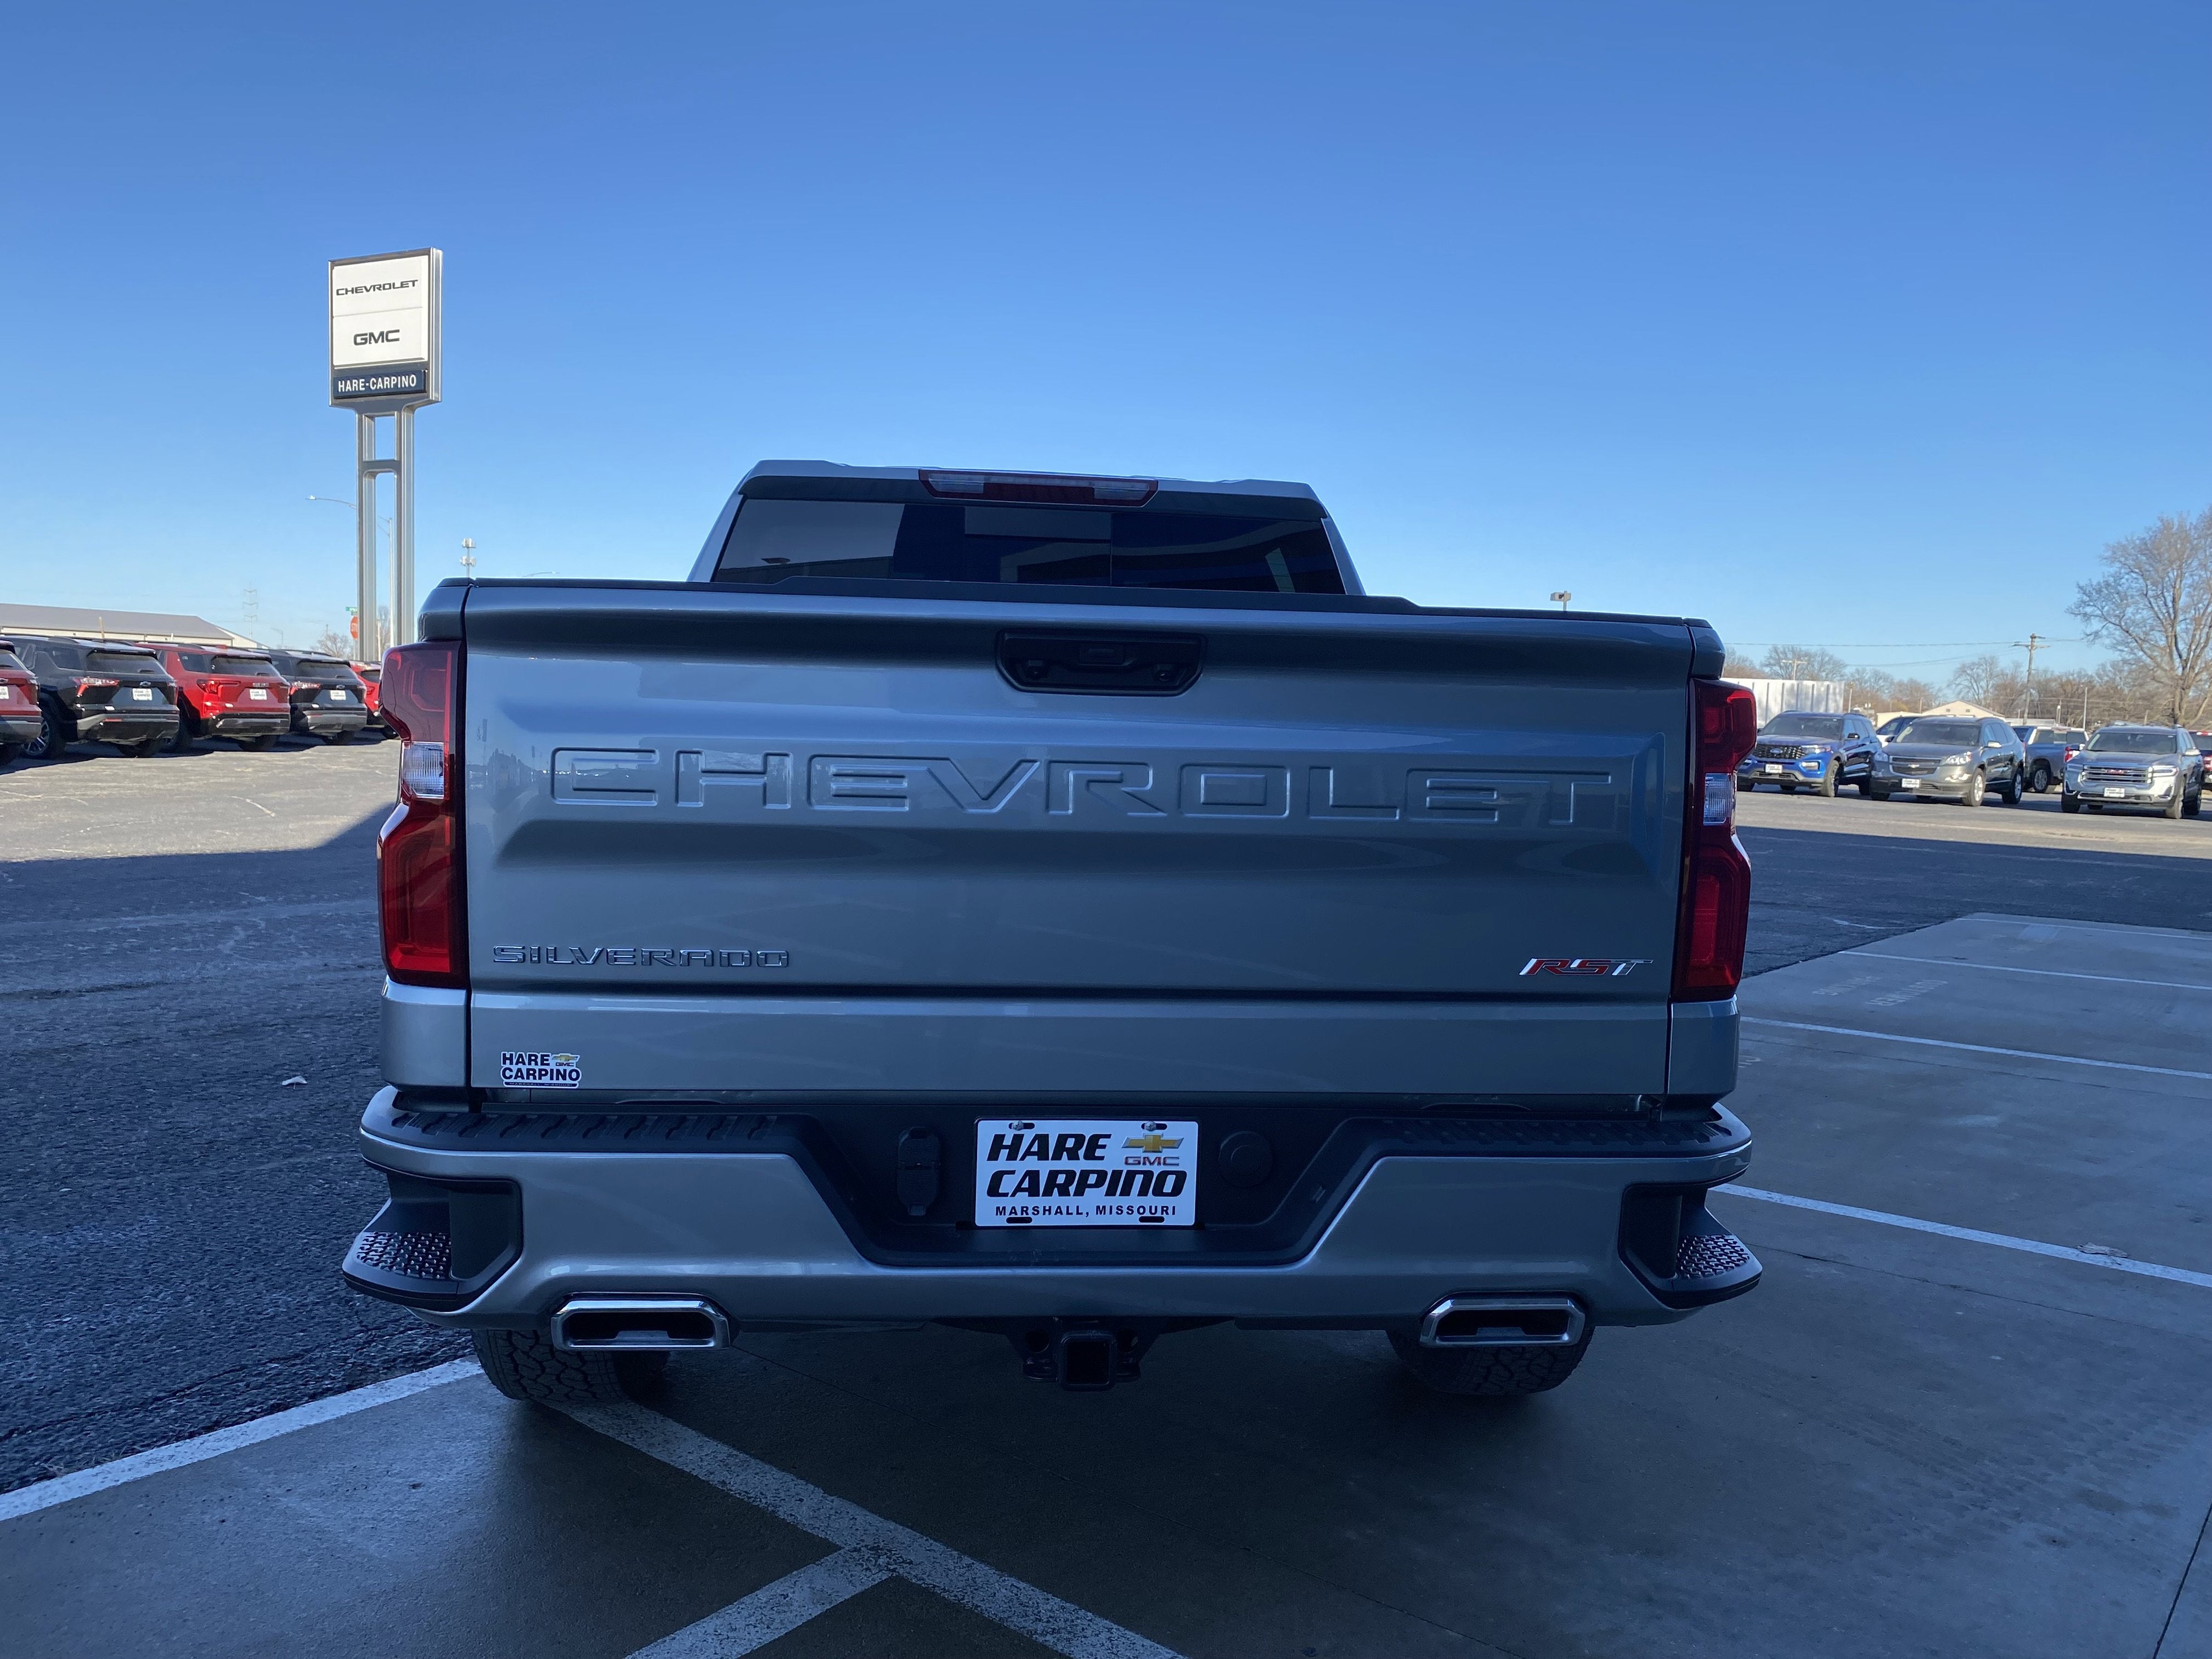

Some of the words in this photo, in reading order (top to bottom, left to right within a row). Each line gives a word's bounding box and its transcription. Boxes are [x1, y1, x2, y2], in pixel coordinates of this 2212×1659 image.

[336, 279, 419, 296] CHEVROLET
[353, 329, 400, 346] GMC
[338, 374, 416, 392] HARE-CARPINO
[551, 747, 1612, 824] CHEVROLET
[493, 945, 789, 968] SILVERADO
[1519, 958, 1654, 975] RST
[502, 1053, 550, 1066] HARE
[501, 1067, 580, 1081] CARPINO
[987, 1133, 1112, 1161] HARE
[1124, 1156, 1180, 1166] GMC
[986, 1169, 1188, 1198] CARPINO
[995, 1205, 1090, 1217] MARSHALL,
[1096, 1205, 1176, 1216] MISSOURI
